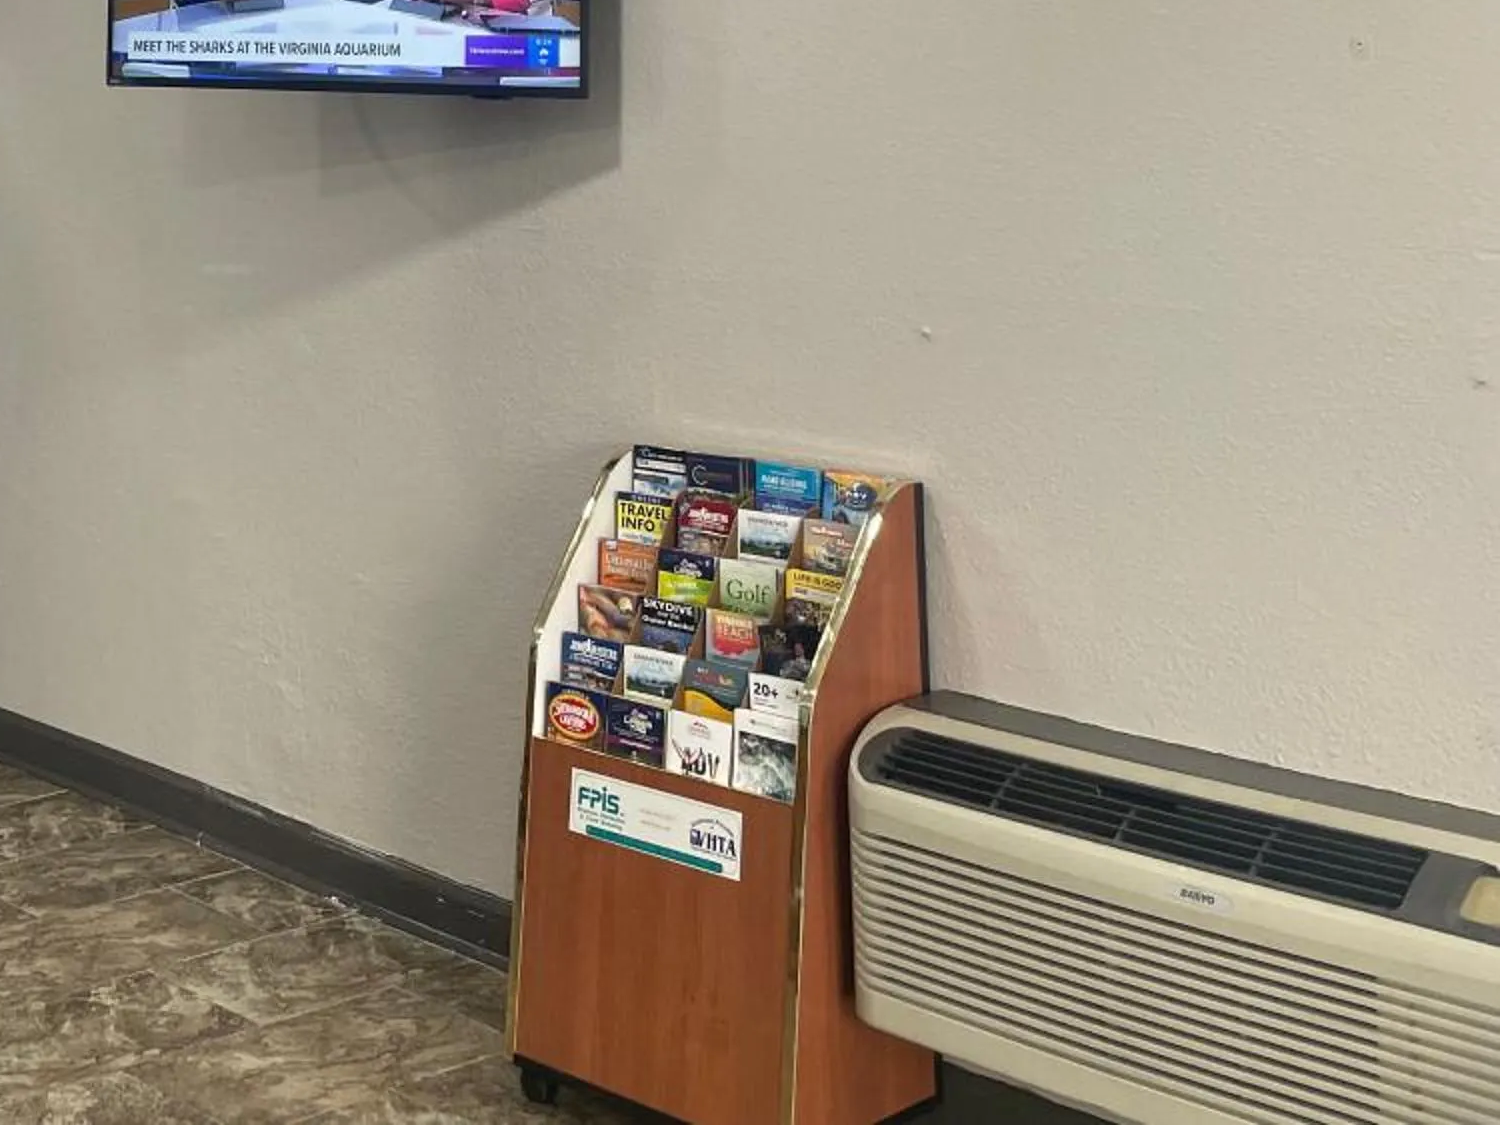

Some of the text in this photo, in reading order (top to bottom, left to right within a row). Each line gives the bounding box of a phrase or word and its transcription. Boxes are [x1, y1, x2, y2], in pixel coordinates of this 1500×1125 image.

[133, 39, 402, 58] MEET THE SHARKS AT THE VIRGINIA AQUARIUM
[620, 502, 668, 522] TRAVEL
[621, 517, 655, 532] INFO
[726, 578, 774, 604] Golf
[643, 598, 693, 616] SKYDIVE
[752, 682, 779, 698] 20+
